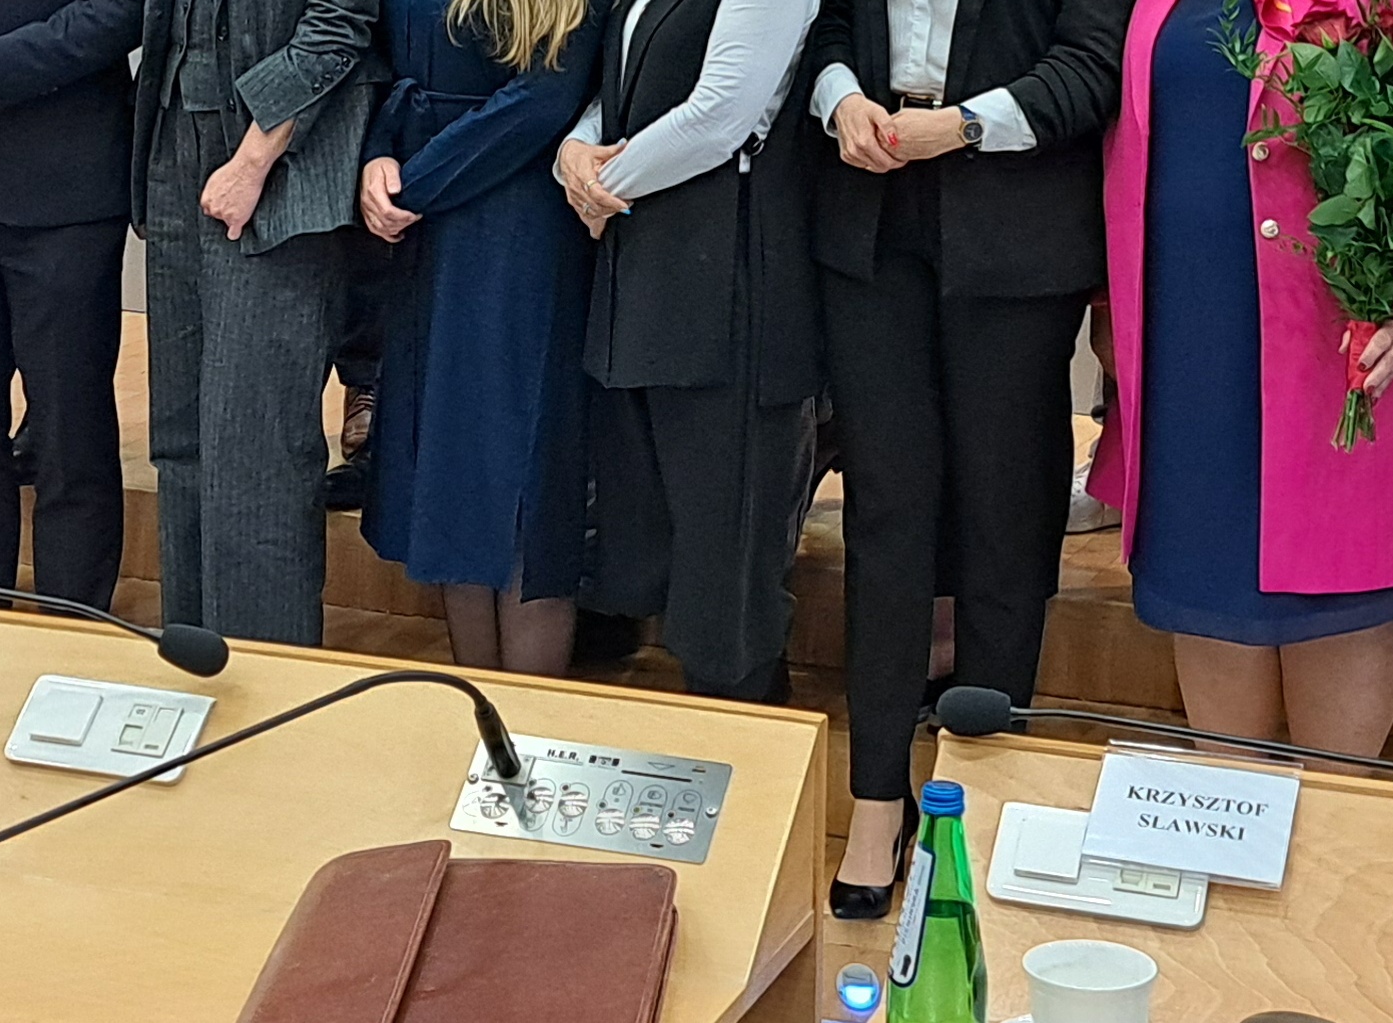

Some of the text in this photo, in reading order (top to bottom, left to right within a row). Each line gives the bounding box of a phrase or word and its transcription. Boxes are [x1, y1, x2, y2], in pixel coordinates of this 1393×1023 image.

[548, 748, 579, 762] H.E.R.
[1127, 785, 1269, 817] KRZYSZTOF
[1138, 813, 1245, 840] SLAWSKI
